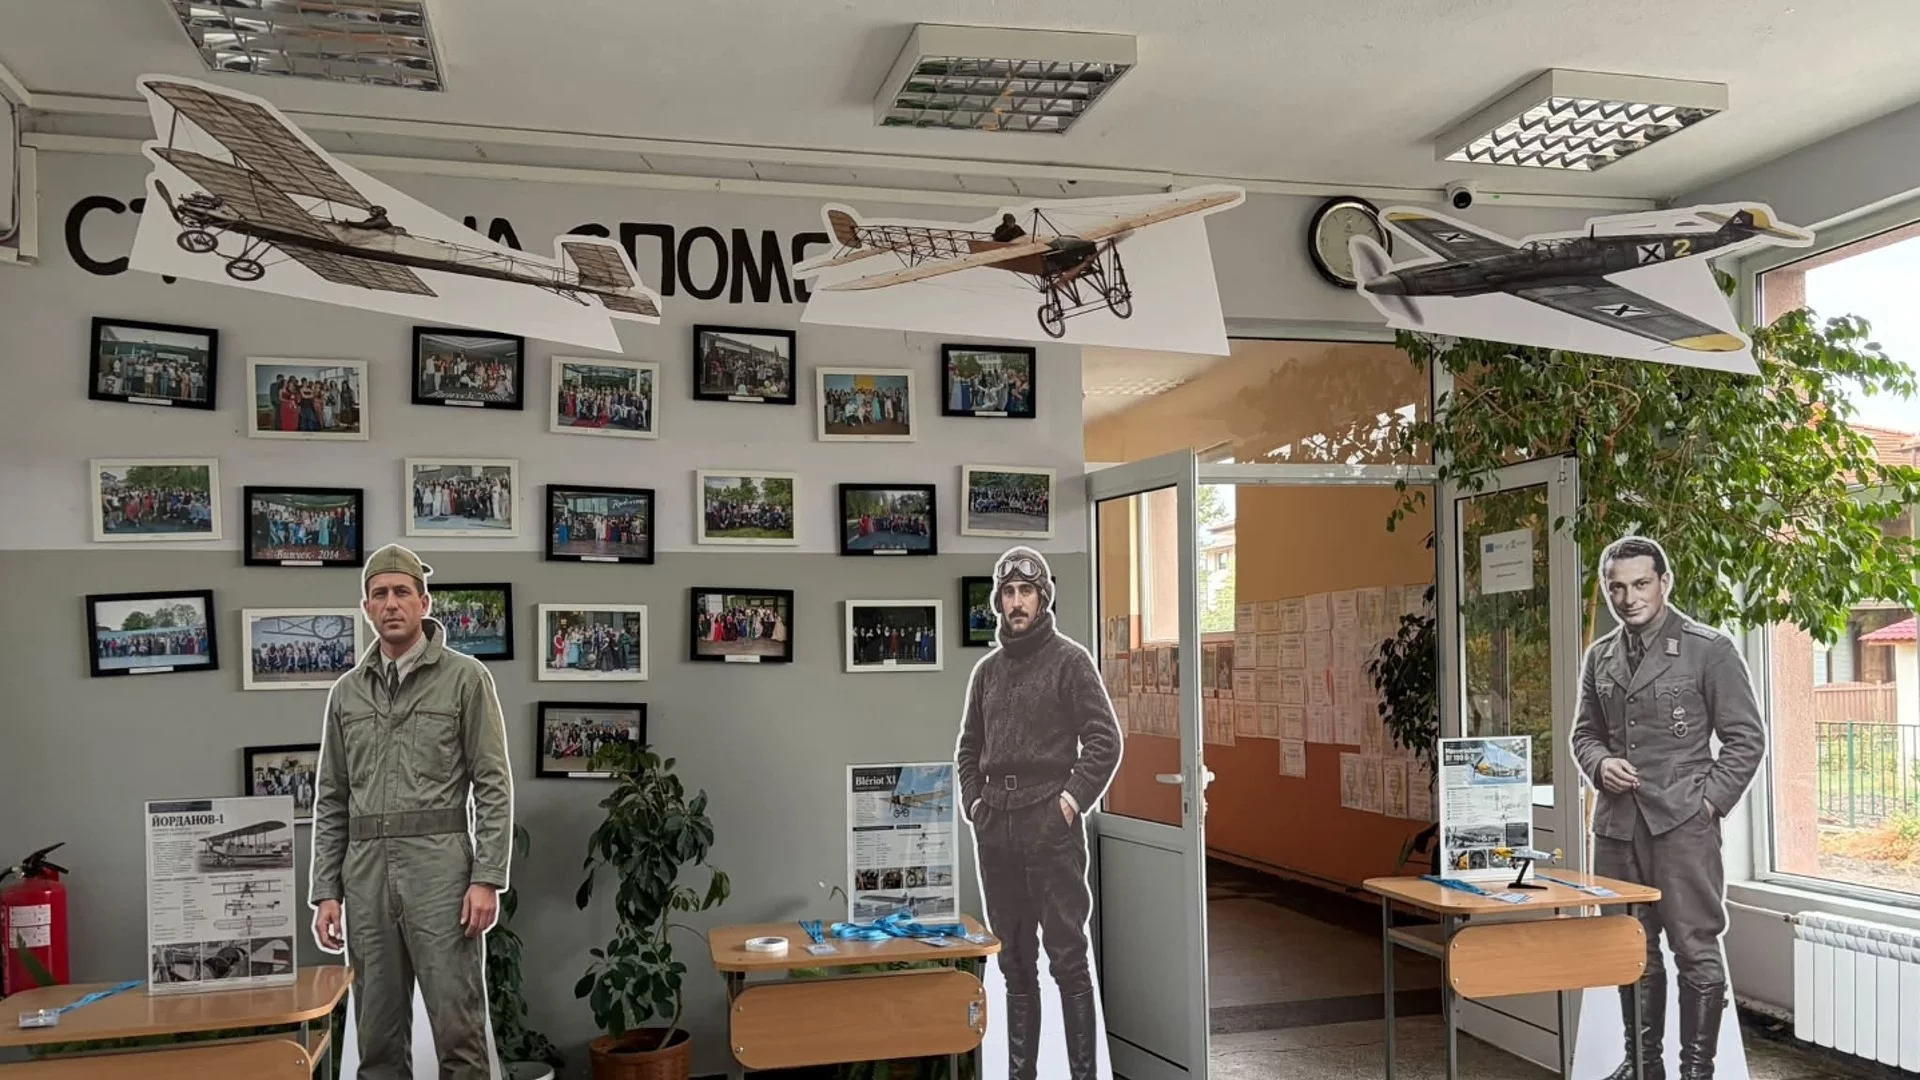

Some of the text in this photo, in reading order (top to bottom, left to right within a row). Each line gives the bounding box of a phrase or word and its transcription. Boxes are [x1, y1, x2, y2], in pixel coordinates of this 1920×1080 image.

[1672, 239, 1691, 257] 2
[566, 222, 831, 304] ПОМ
[855, 775, 884, 786] Blériot
[152, 813, 224, 828] ЙОРДАНОВ-1
